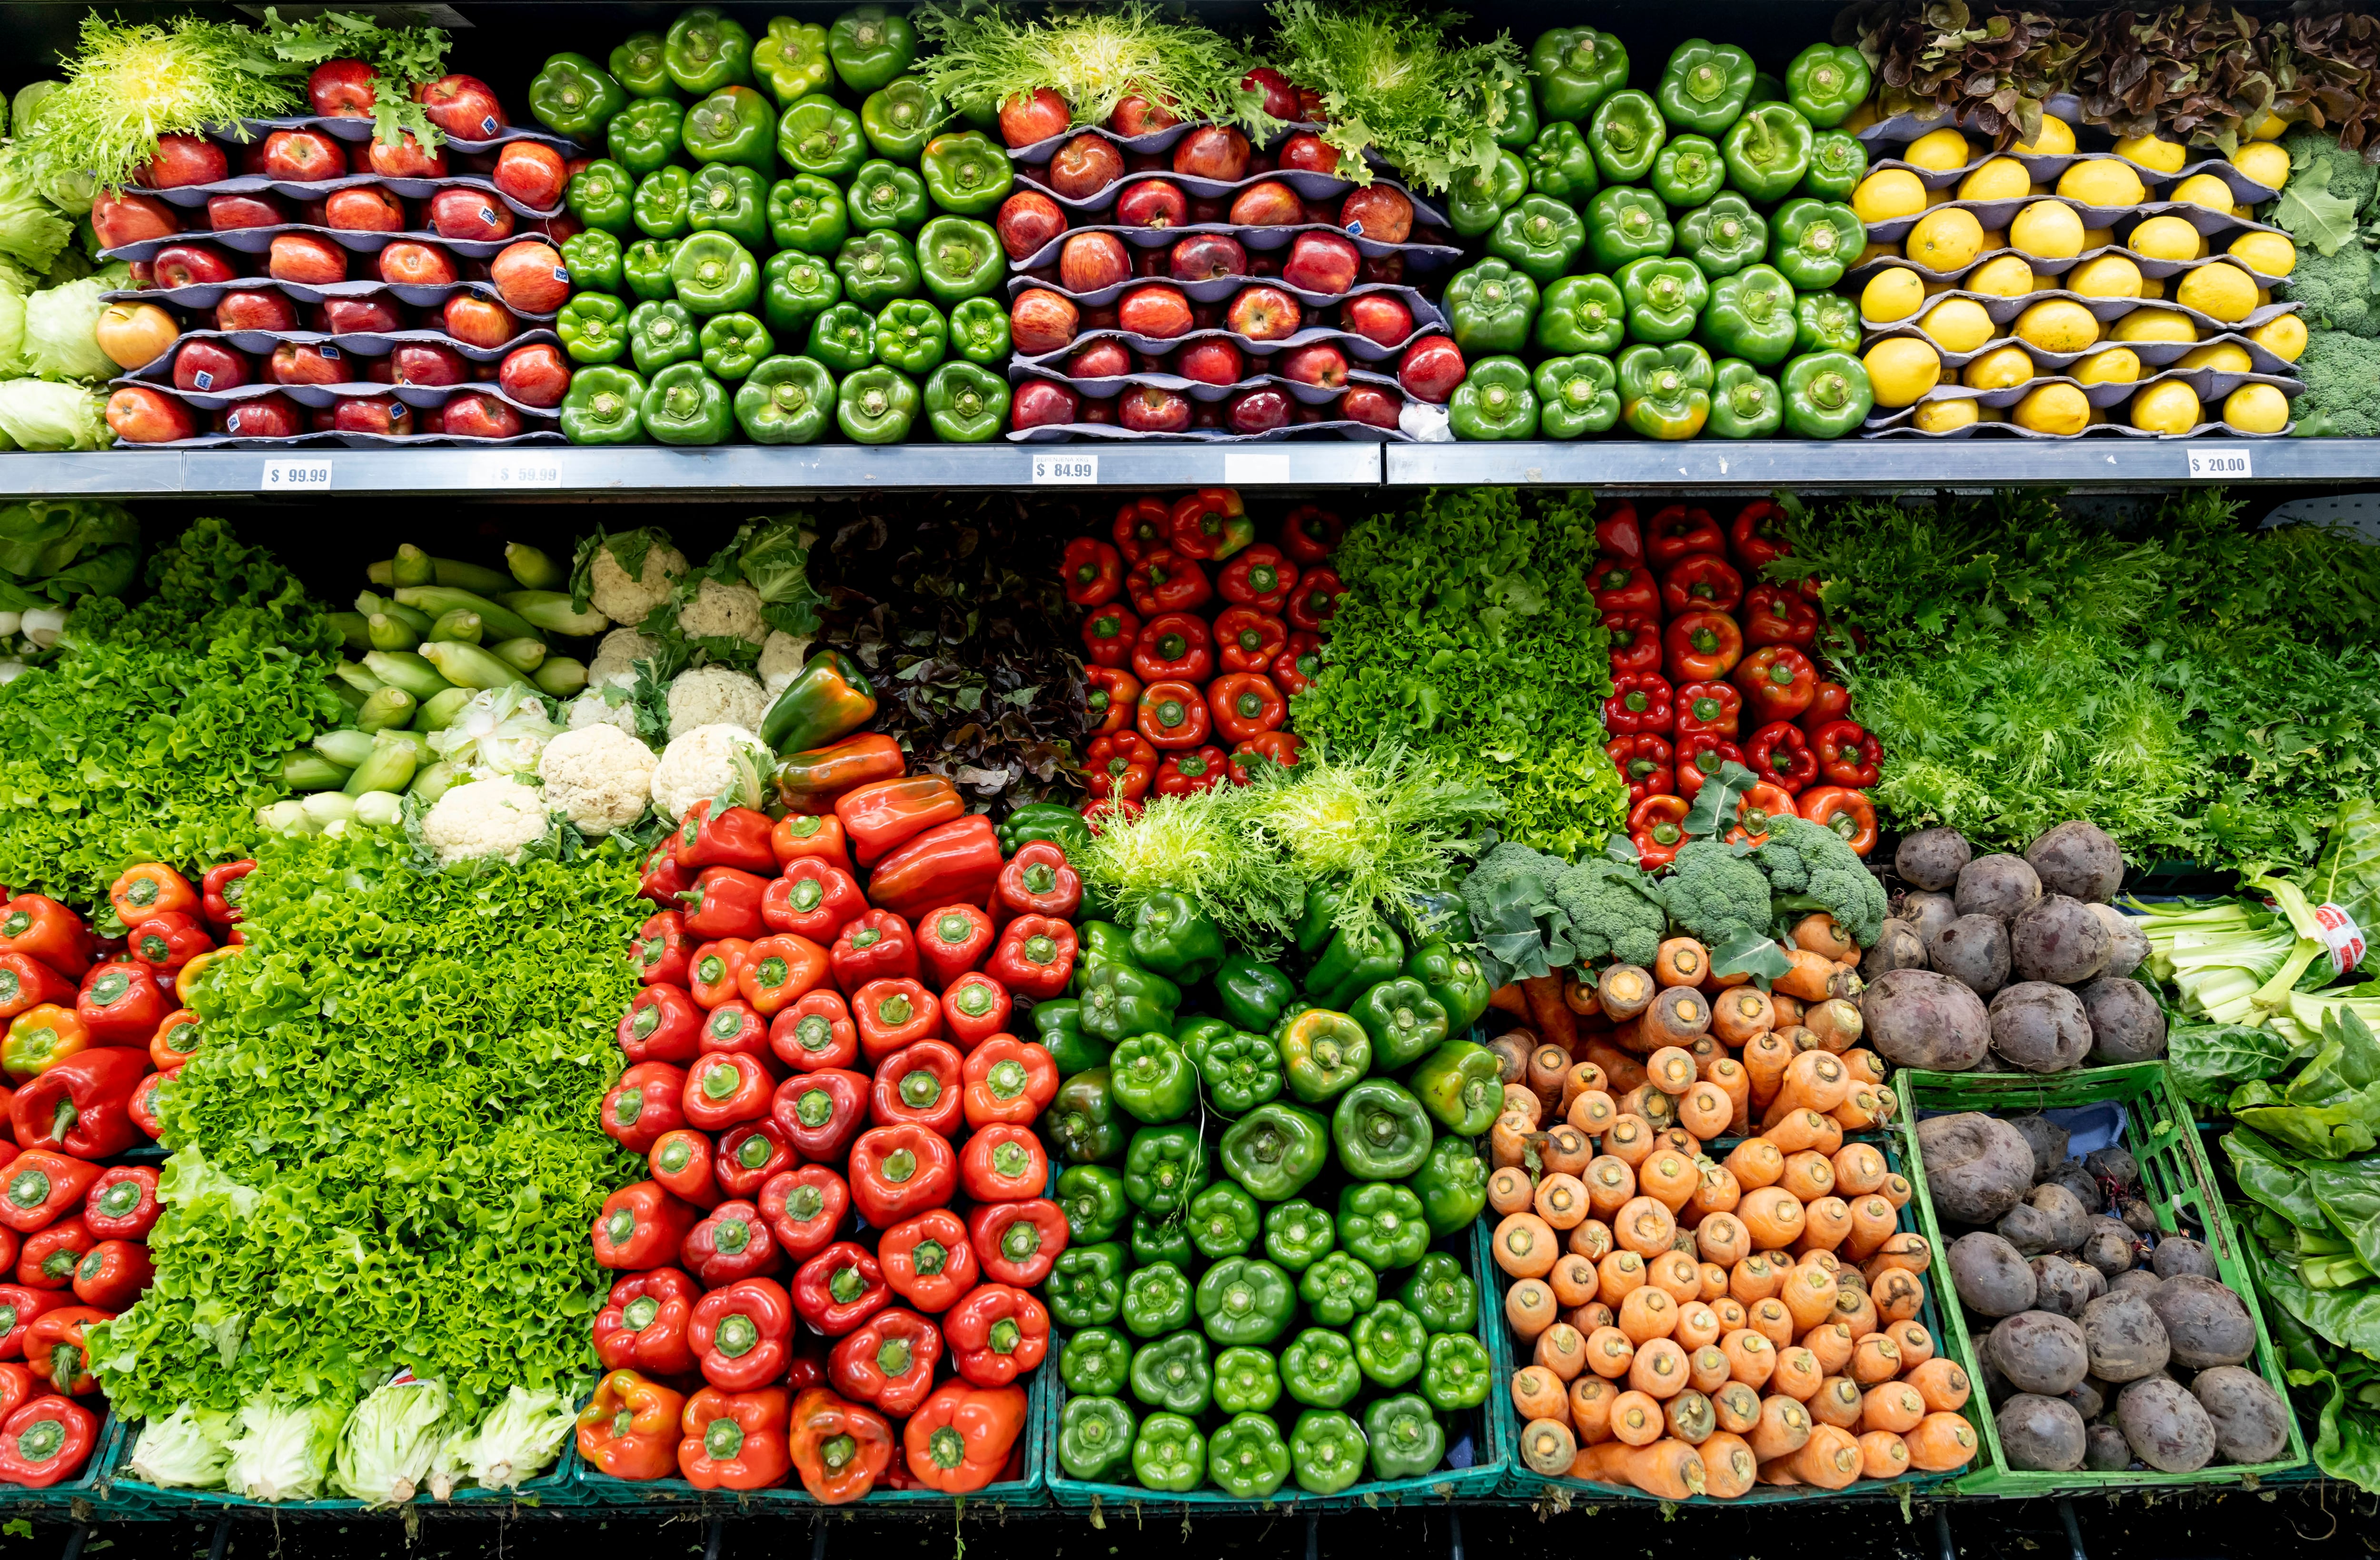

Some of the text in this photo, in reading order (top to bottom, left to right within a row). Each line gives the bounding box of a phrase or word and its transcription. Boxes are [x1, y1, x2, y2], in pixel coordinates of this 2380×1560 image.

[1037, 463, 1091, 477] $ 84.99
[2192, 458, 2245, 472] $ 20.00
[271, 469, 327, 483] $ 99.99
[501, 468, 556, 482] $ 59.99
